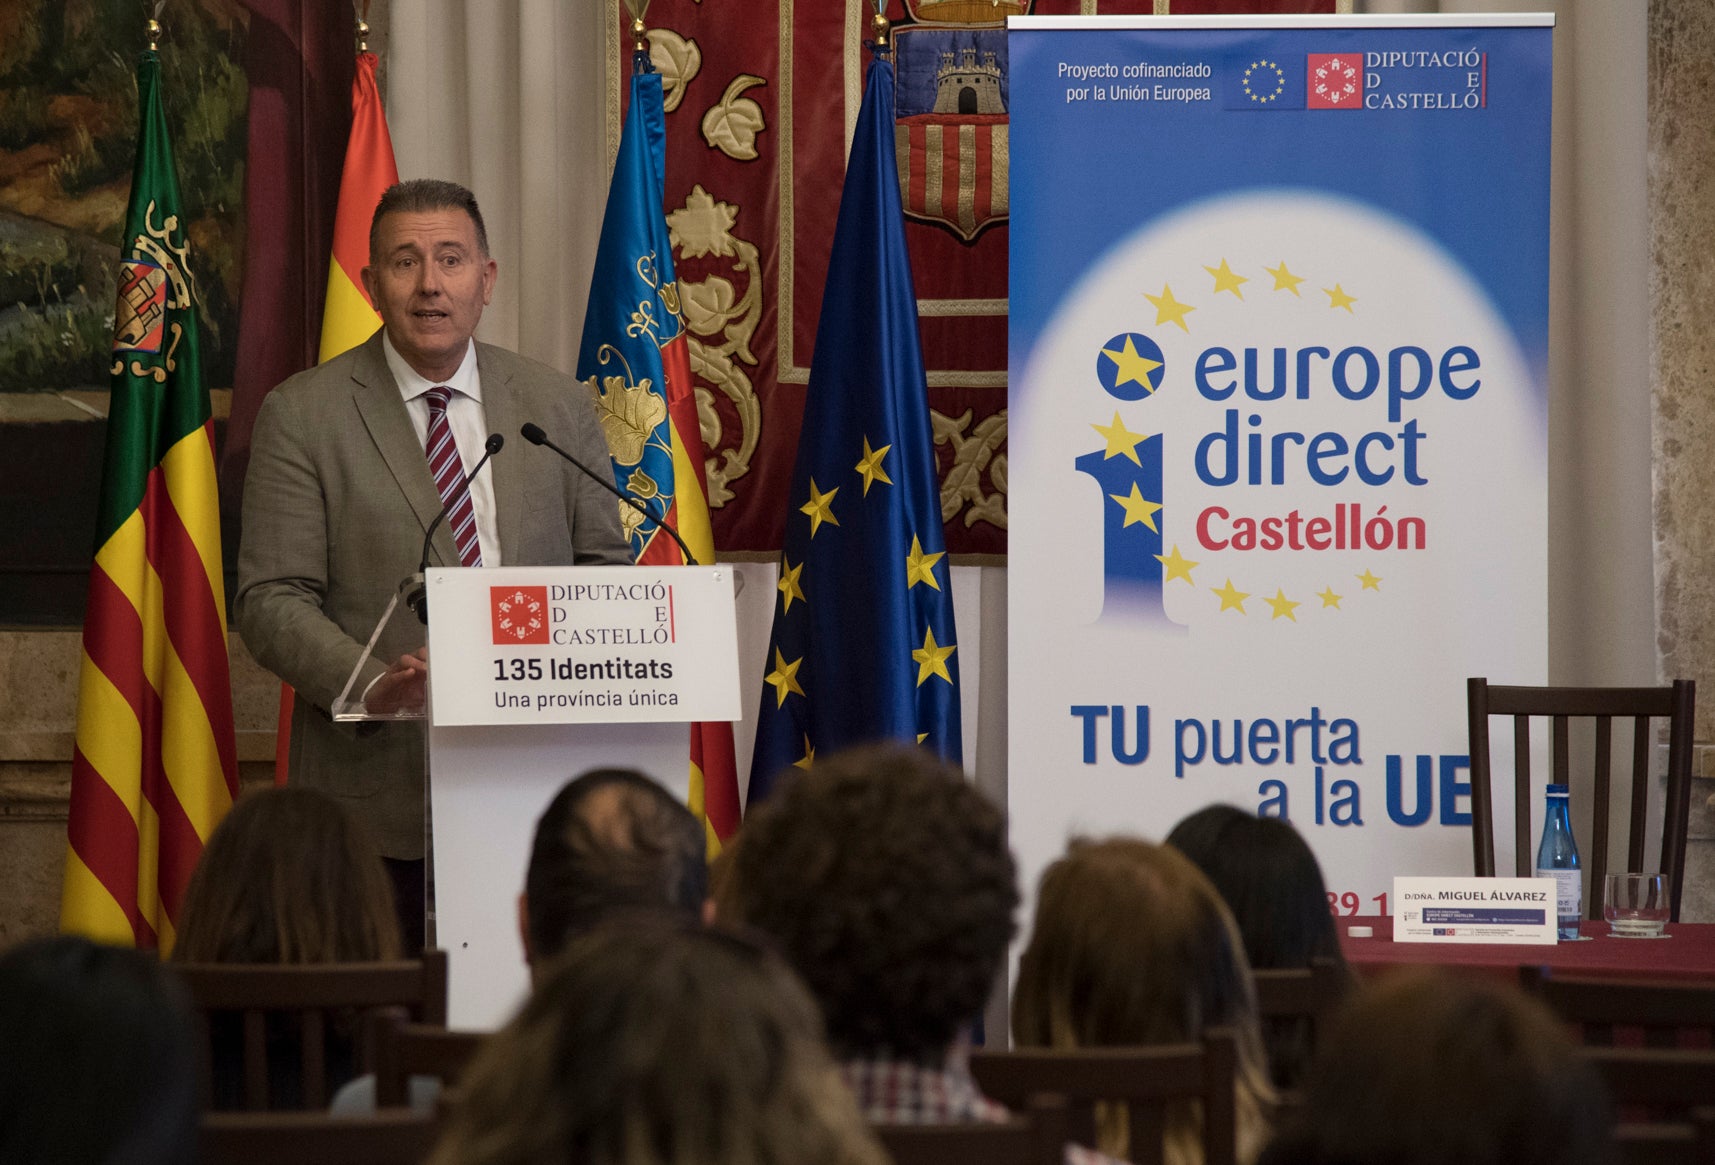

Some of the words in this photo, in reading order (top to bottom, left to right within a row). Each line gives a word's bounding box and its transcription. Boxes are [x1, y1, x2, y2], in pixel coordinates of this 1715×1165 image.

[1368, 48, 1479, 66] DIPUTACIÓ
[1059, 63, 1118, 80] Proyecto
[1123, 63, 1210, 77] cofinanciado
[1066, 87, 1090, 103] por
[1095, 86, 1105, 100] la
[1111, 85, 1148, 100] Unión
[1155, 86, 1210, 103] Europea
[1366, 90, 1478, 108] CASTELLÓ
[1194, 345, 1481, 422] europe
[1194, 408, 1429, 487] direct
[1196, 504, 1425, 551] Castellón
[552, 580, 665, 600] DIPUTACIÓ
[553, 624, 668, 645] CASTELLÓ
[494, 659, 542, 680] 135
[551, 657, 672, 680] Identitats
[495, 692, 530, 707] Una
[538, 690, 622, 711] província
[629, 689, 678, 705] única
[1071, 705, 1148, 764] TU
[1174, 707, 1362, 778] puerta
[1258, 779, 1288, 822] a
[1315, 766, 1362, 825] la
[1386, 755, 1473, 828] UE
[1439, 892, 1486, 900] MIGUEL
[1491, 891, 1546, 901] ÁLVAREZ
